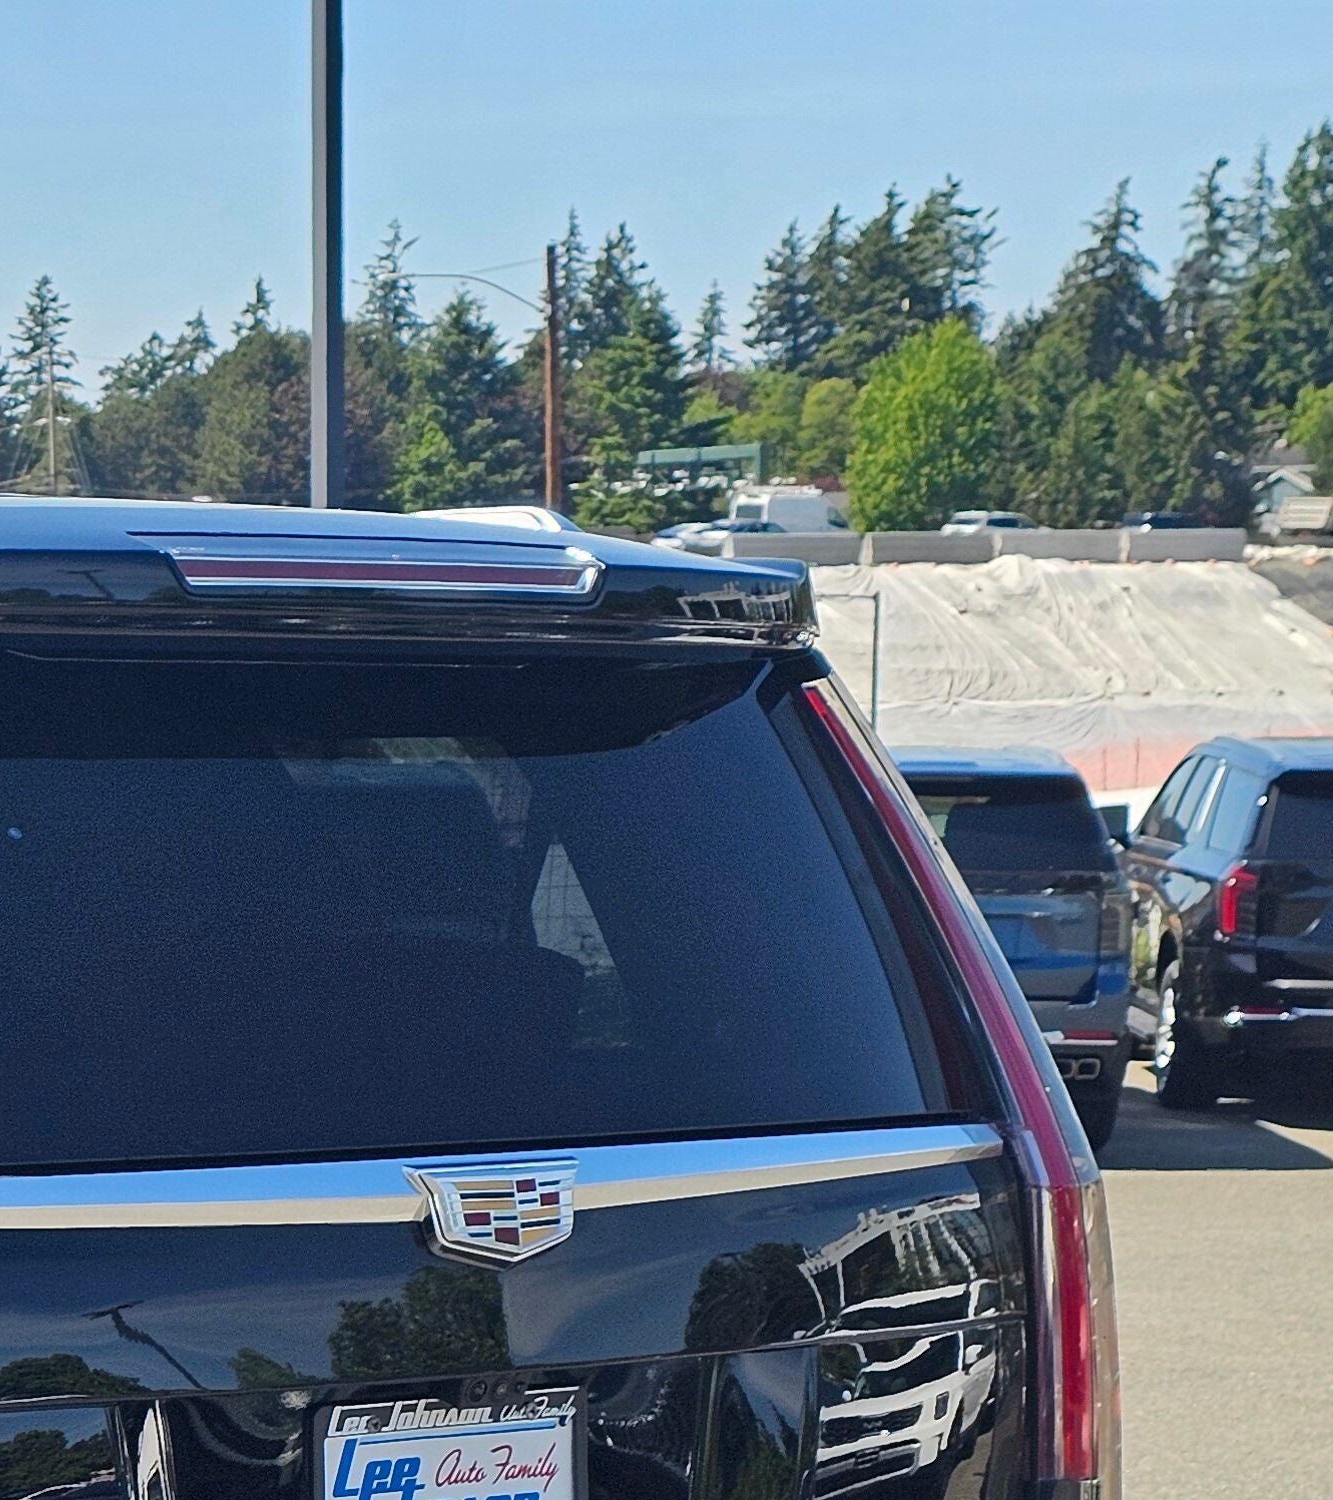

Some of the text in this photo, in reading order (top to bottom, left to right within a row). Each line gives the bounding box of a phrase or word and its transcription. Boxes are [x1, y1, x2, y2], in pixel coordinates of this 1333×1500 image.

[381, 1399, 494, 1432] Johnson
[500, 1404, 535, 1421] Aut
[533, 1394, 577, 1425] Family
[332, 1438, 559, 1498] Lee Auto Family
